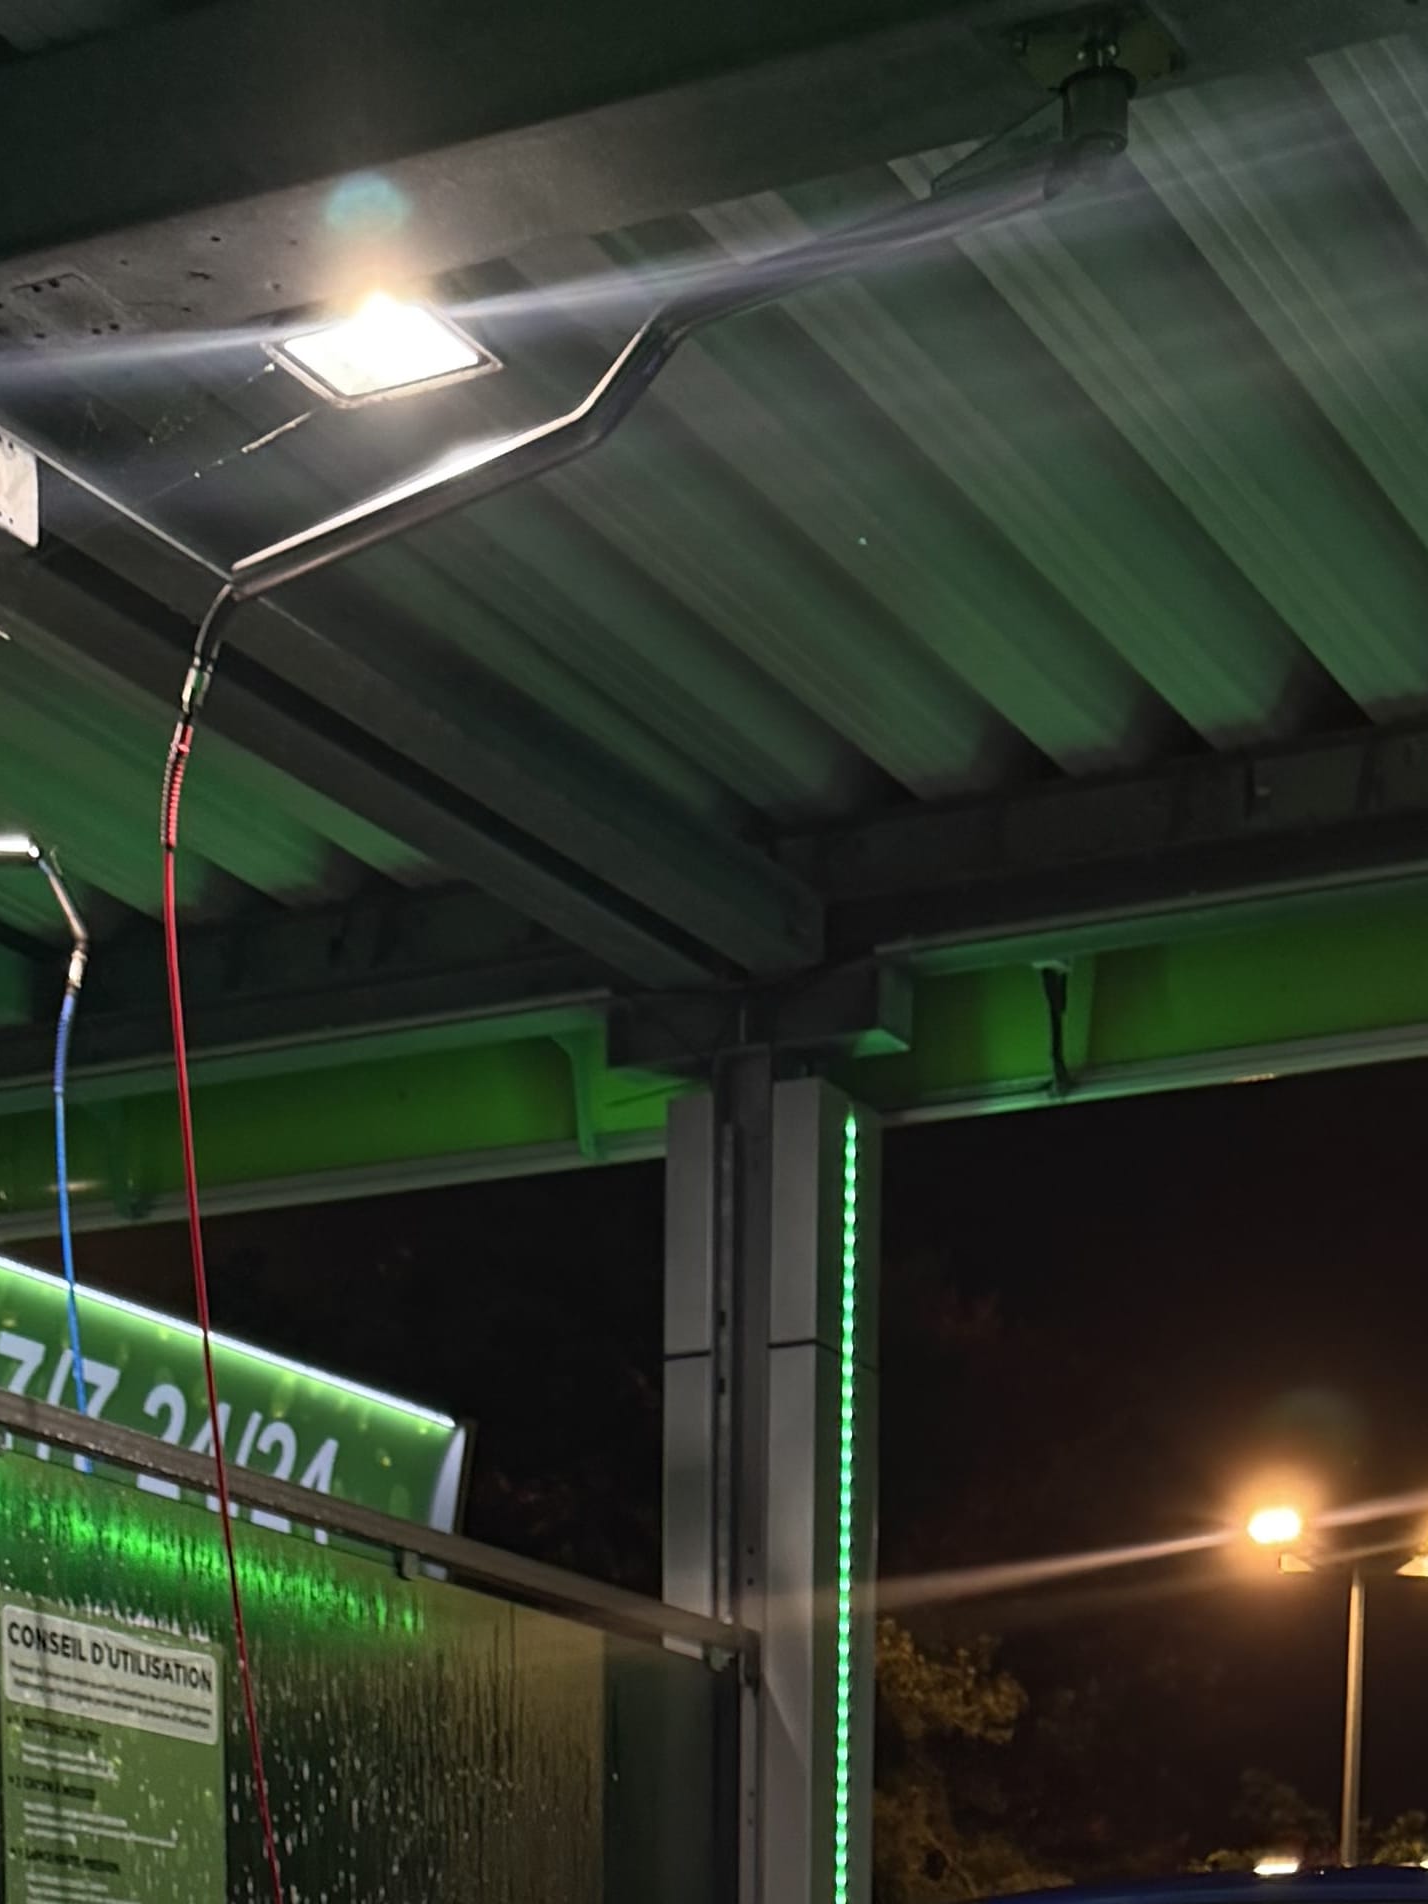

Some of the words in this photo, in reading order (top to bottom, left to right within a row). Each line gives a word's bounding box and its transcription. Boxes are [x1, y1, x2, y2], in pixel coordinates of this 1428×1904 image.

[136, 1383, 339, 1546] 24/24
[7, 1621, 88, 1663] CONSEIL
[90, 1641, 212, 1692] D'UTILISATION
